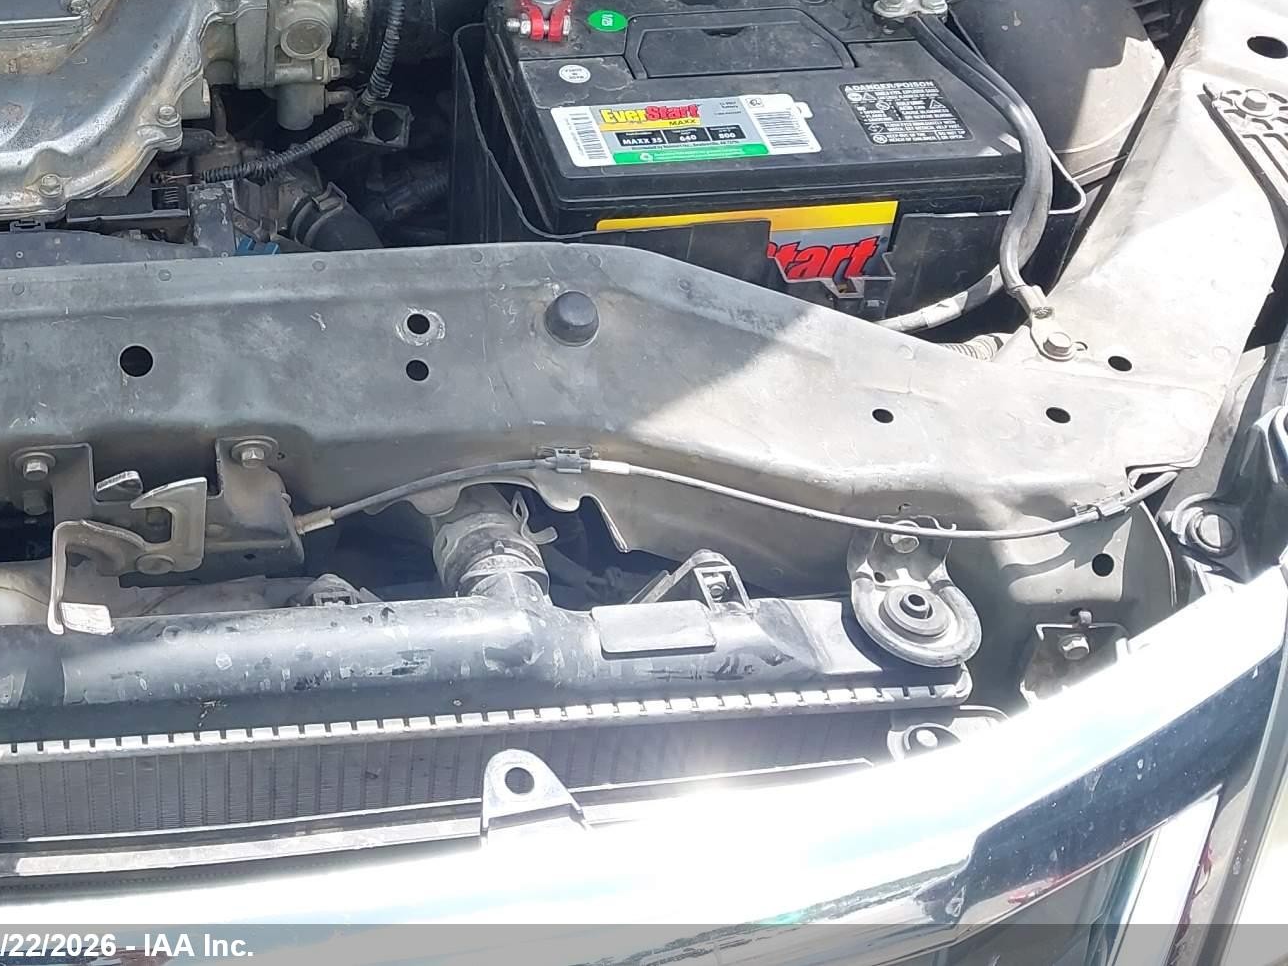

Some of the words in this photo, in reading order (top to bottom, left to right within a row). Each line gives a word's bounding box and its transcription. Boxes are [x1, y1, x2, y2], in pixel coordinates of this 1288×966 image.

[600, 103, 699, 124] EverStart
[669, 119, 696, 127] MAXX
[622, 137, 651, 145] MAXX
